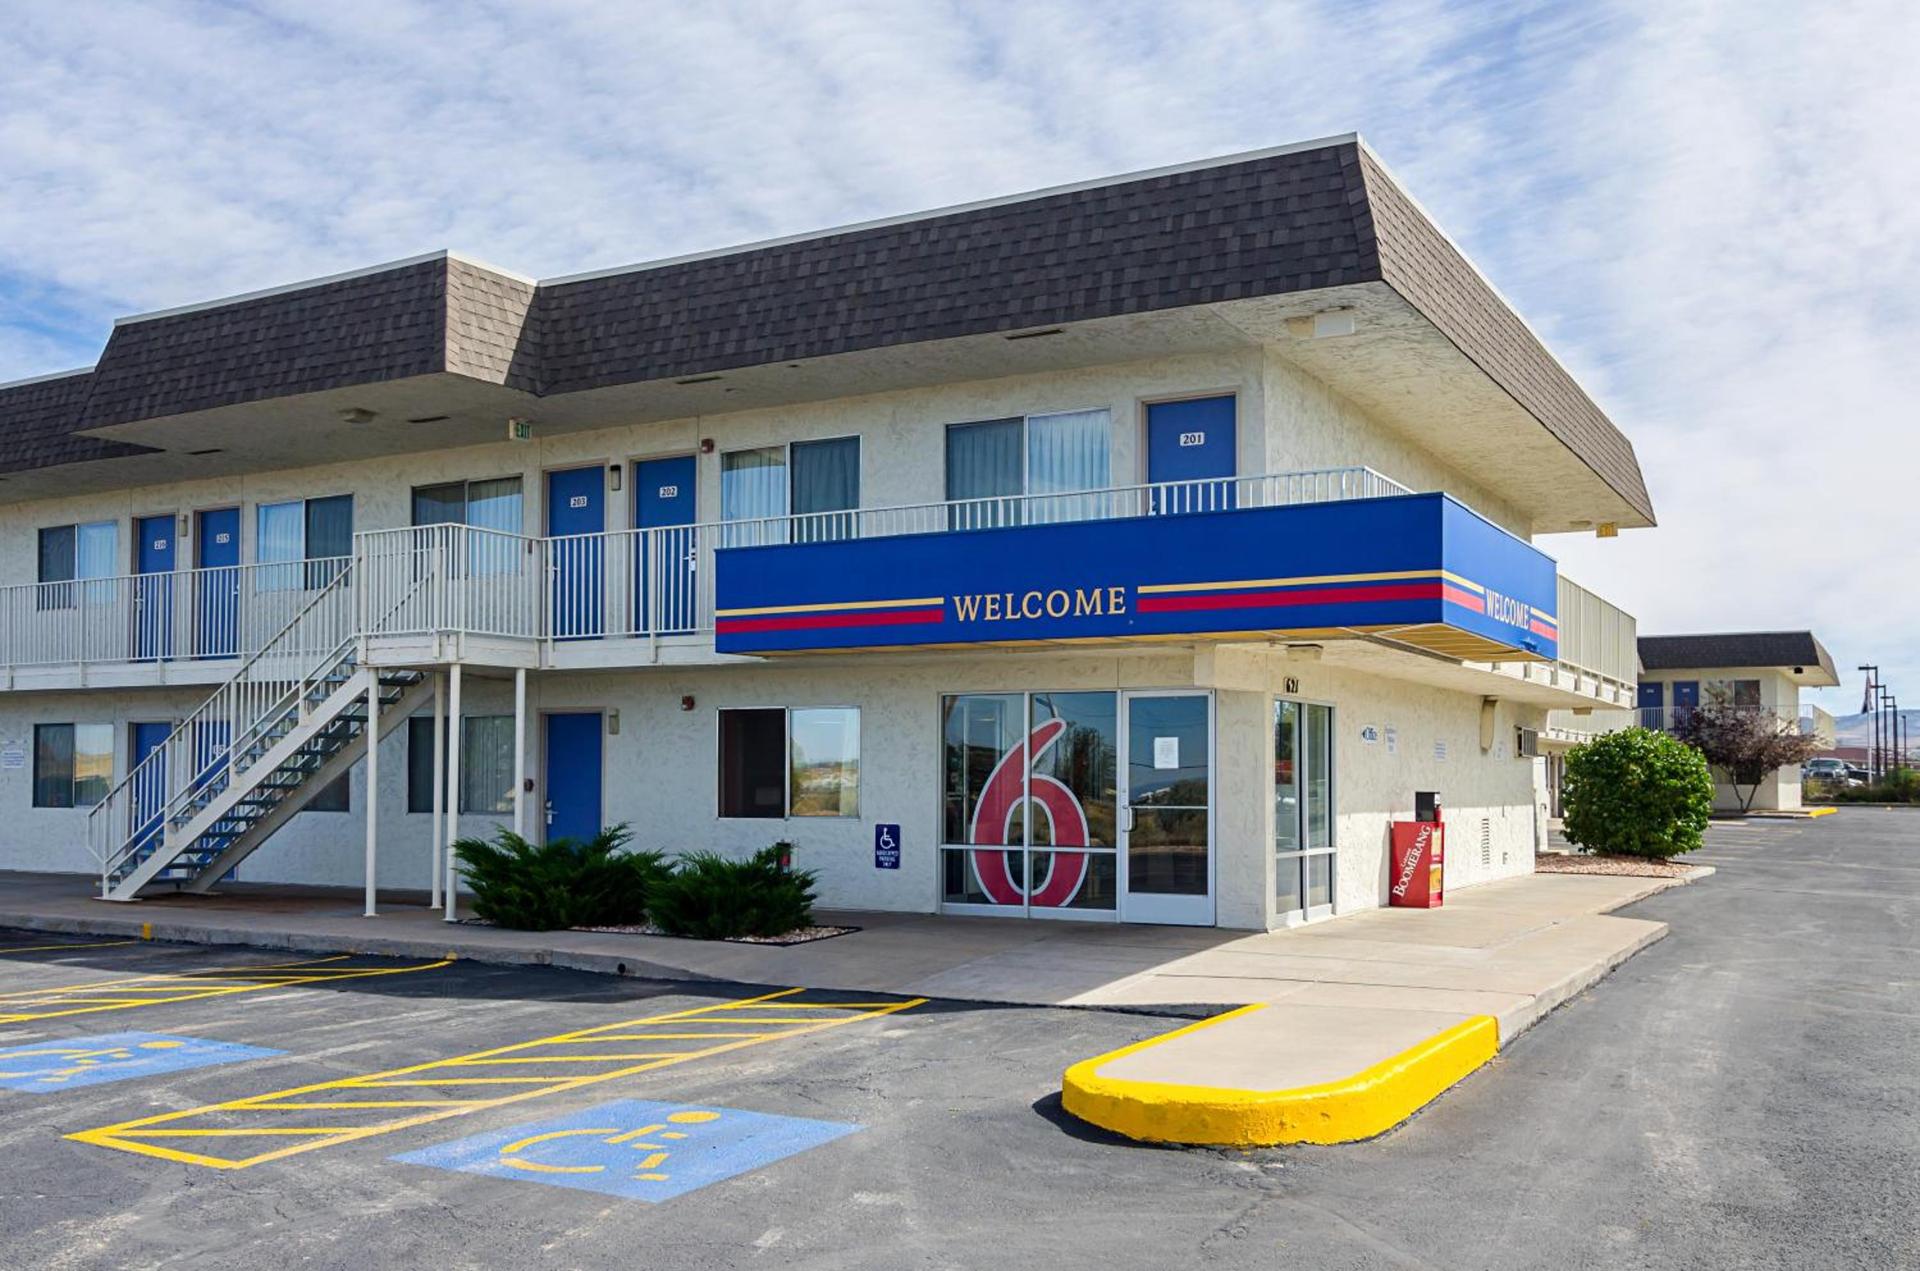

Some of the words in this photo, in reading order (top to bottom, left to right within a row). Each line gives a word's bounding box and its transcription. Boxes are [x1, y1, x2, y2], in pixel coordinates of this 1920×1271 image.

[1183, 434, 1202, 445] 201
[571, 497, 586, 507] 203
[661, 486, 676, 497] 202
[953, 586, 1127, 622] WELCOME
[1485, 587, 1530, 631] WELCOME
[970, 717, 1091, 907] 6
[1392, 825, 1431, 897] BOOMERANG
